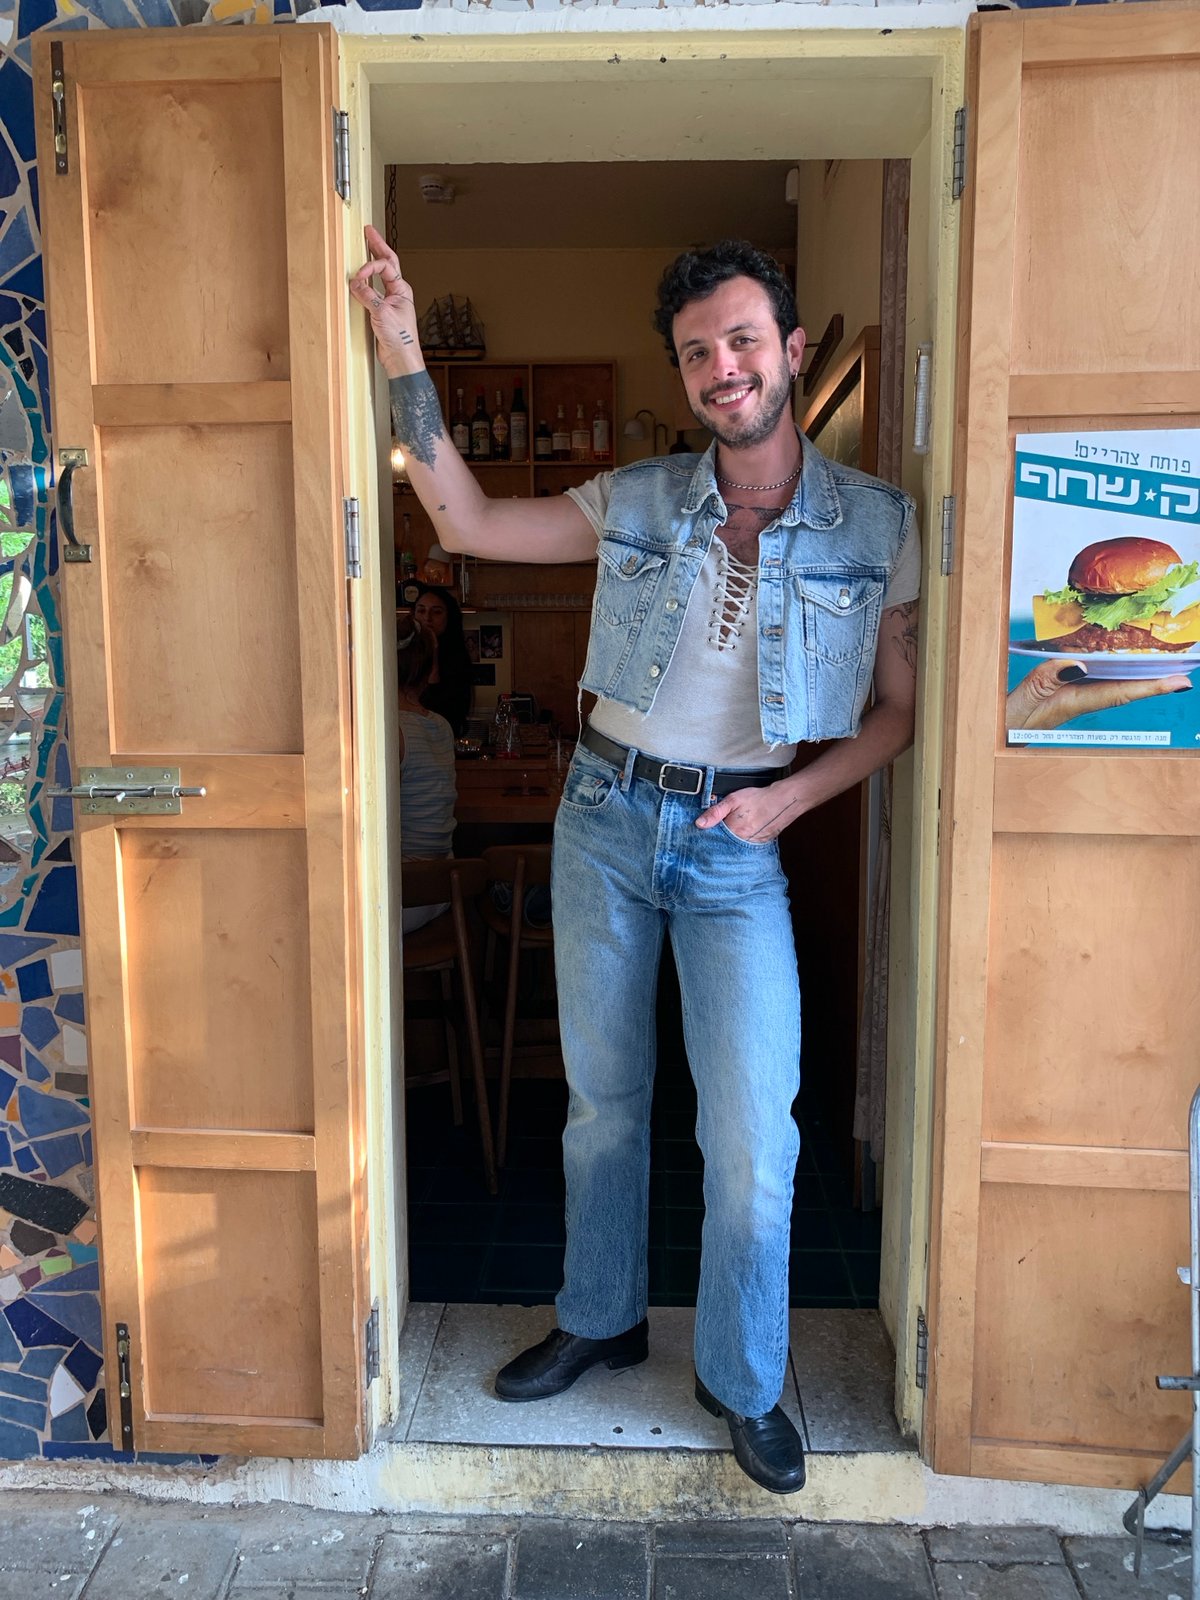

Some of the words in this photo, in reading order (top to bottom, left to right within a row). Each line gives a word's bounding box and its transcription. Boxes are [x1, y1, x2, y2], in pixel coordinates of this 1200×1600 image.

[1074, 440, 1140, 466] צהריים!
[1150, 455, 1191, 474] פותח
[1020, 462, 1140, 506] שחף
